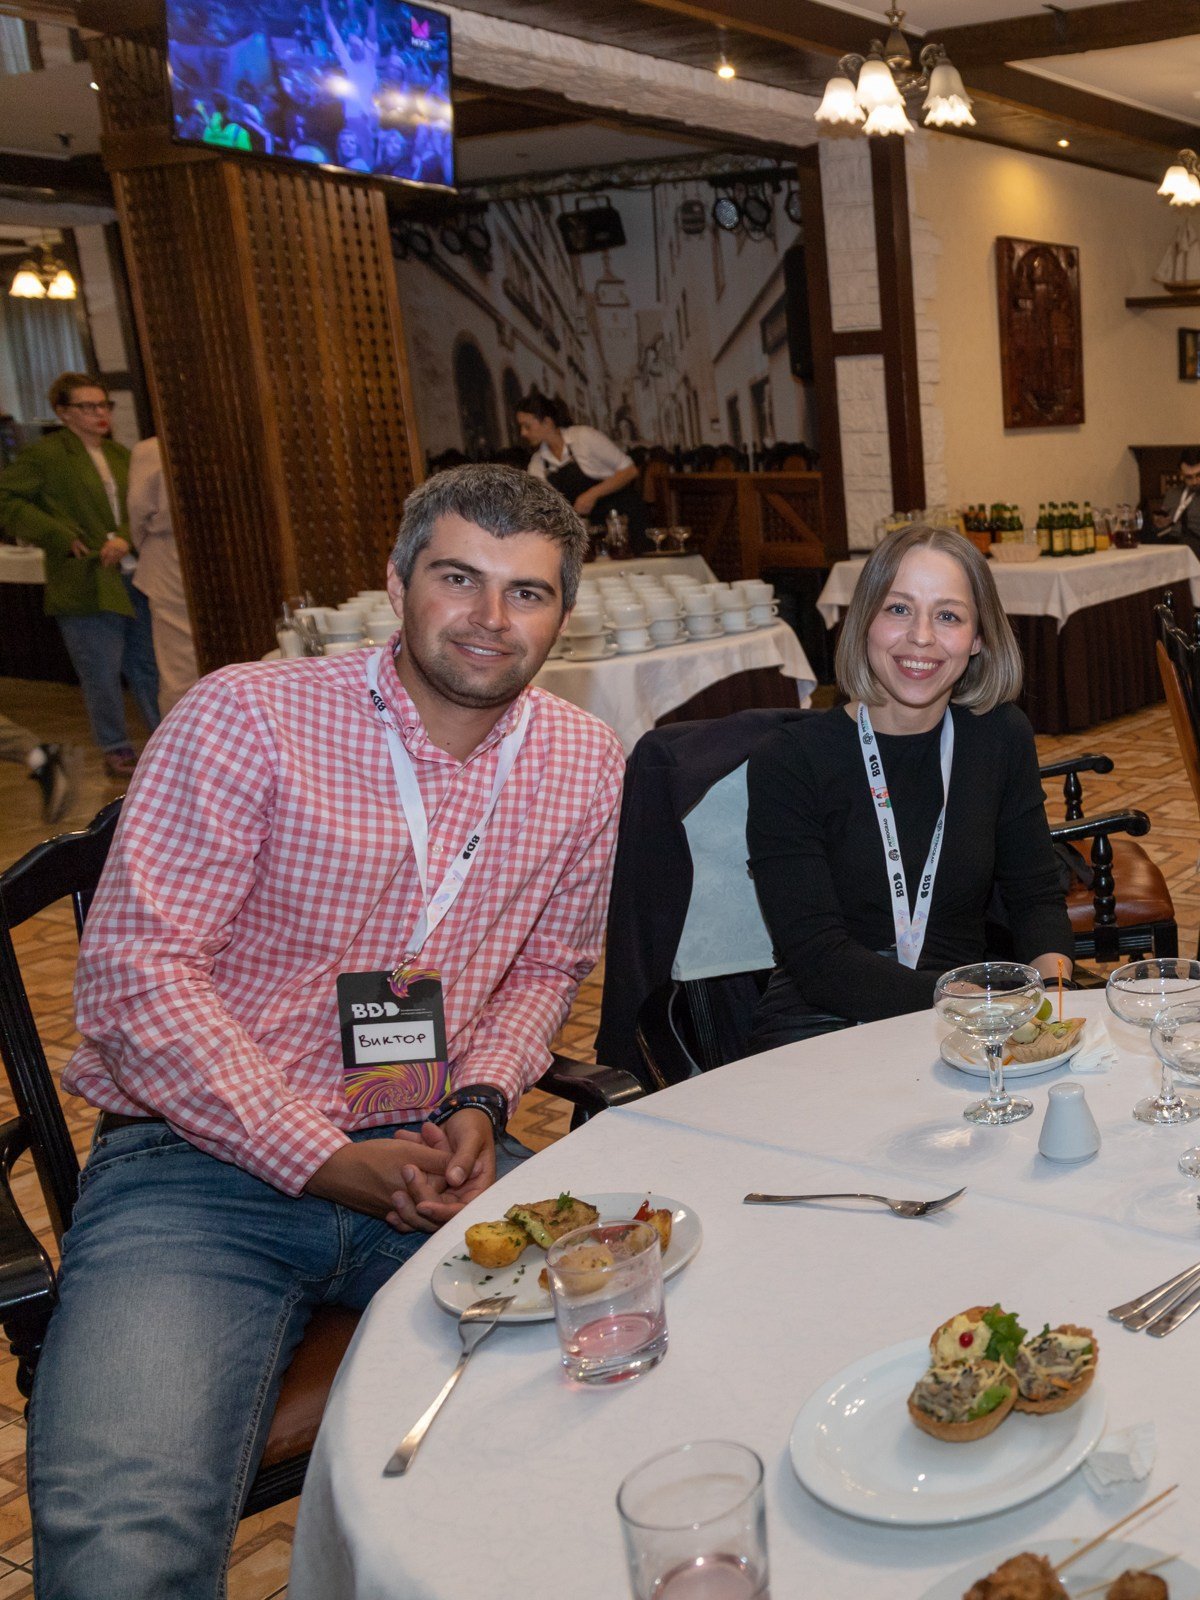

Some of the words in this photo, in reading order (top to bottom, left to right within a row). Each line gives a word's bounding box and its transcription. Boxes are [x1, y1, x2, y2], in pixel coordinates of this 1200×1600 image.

[869, 754, 881, 777] BDD
[883, 818, 892, 847] PETROGRAD
[462, 835, 480, 860] BDD
[893, 872, 904, 898] BDD
[920, 874, 932, 898] BDD
[351, 1001, 400, 1019] BDD
